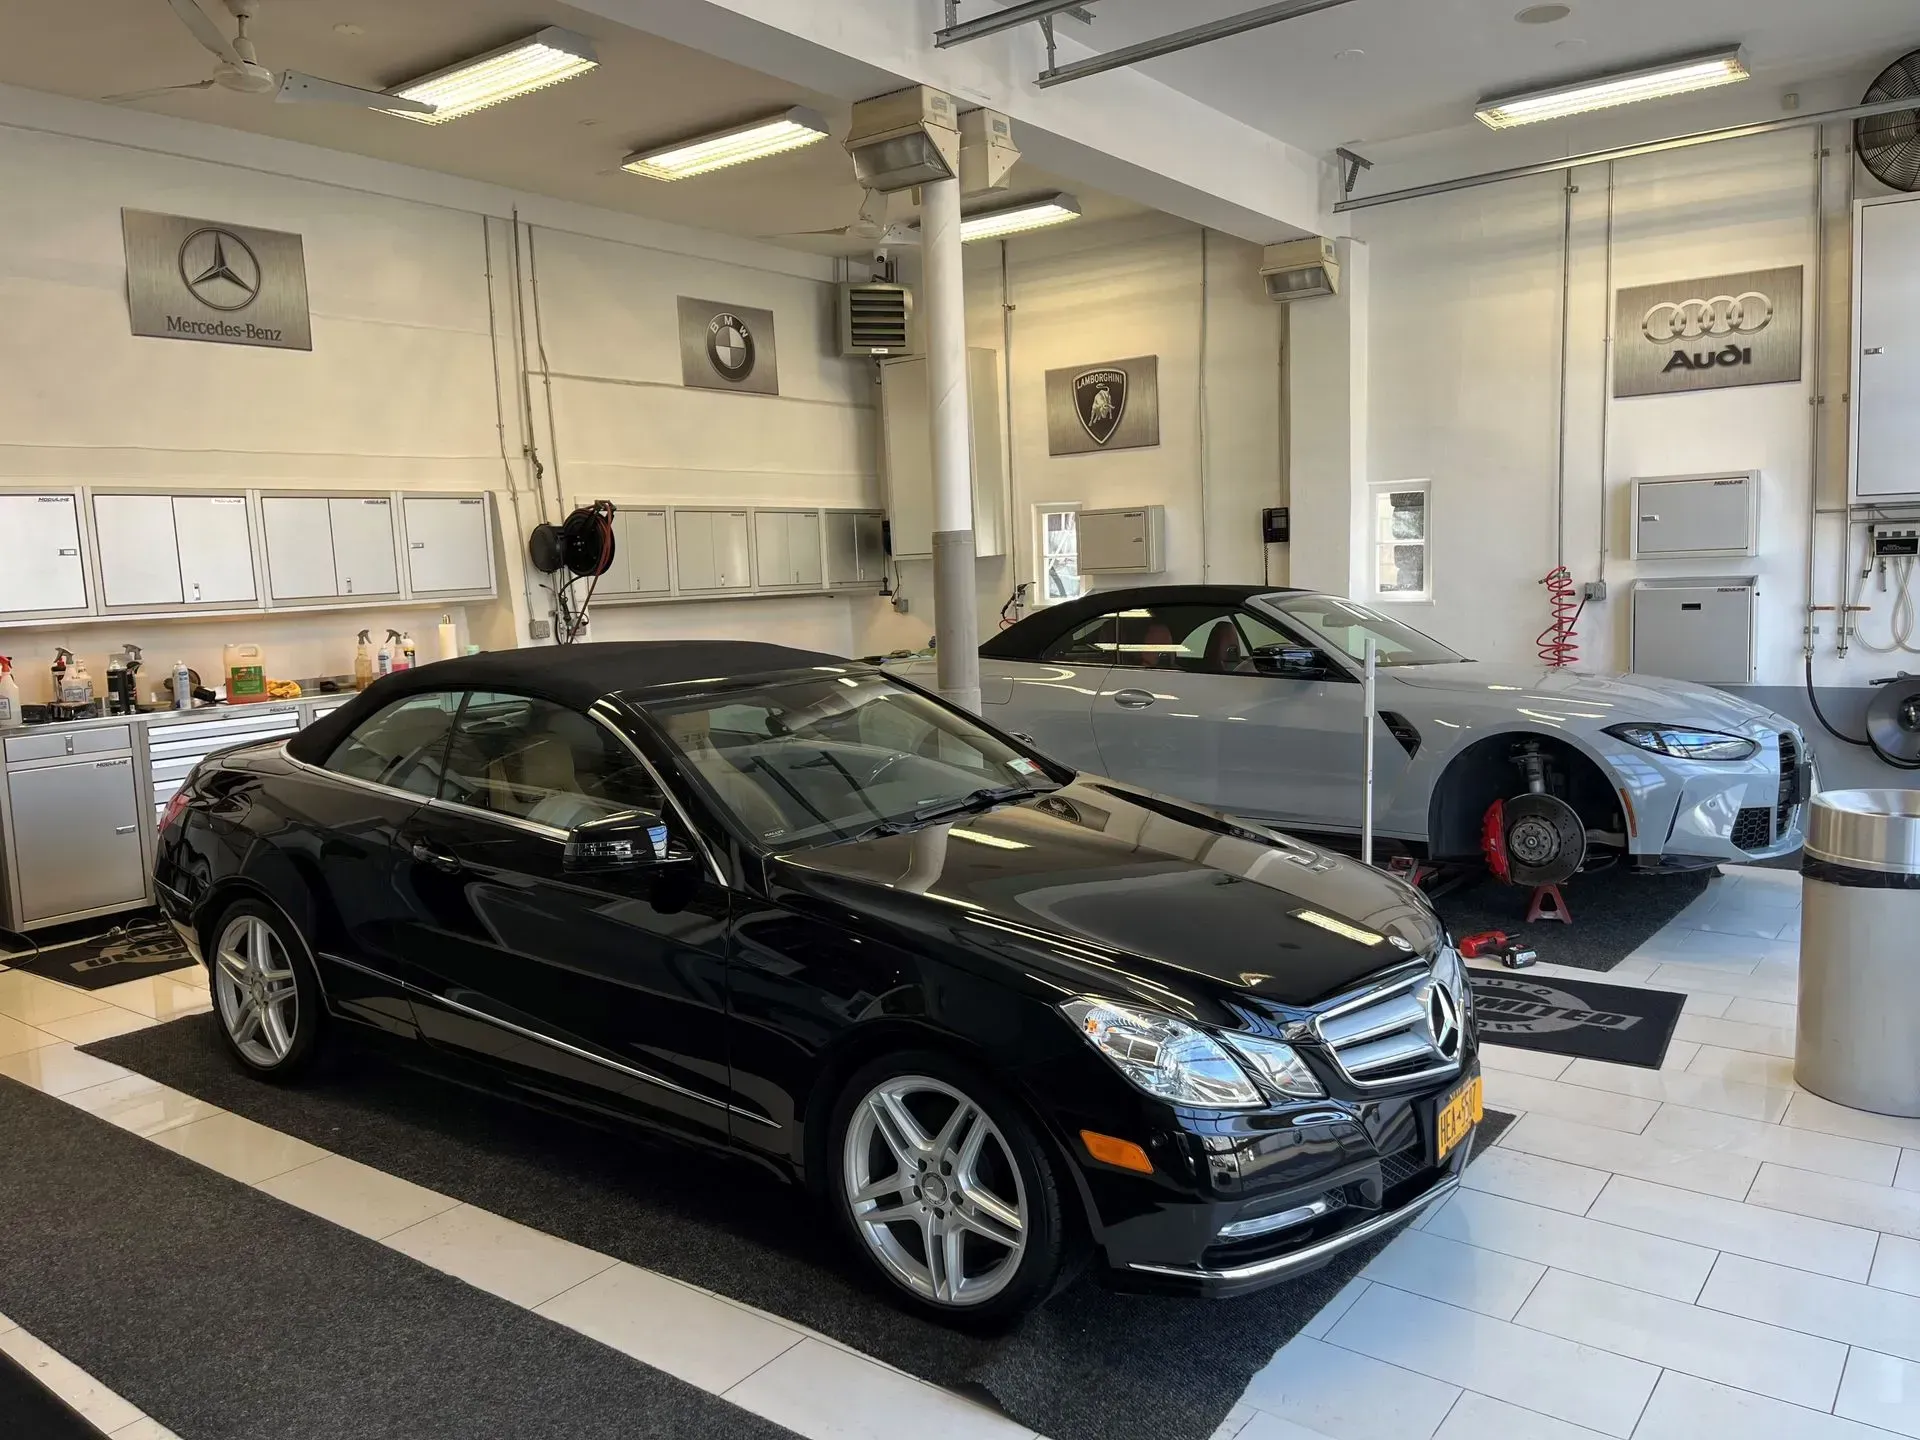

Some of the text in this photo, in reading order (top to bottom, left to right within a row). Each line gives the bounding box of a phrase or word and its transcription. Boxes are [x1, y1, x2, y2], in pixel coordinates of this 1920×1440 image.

[166, 315, 282, 341] Mercedes-Benz
[710, 315, 749, 338] BMW
[1661, 344, 1751, 373] Audi
[1076, 372, 1123, 390] LAMBORGHINI
[1470, 979, 1554, 996] UTO
[1474, 996, 1627, 1026] MITED
